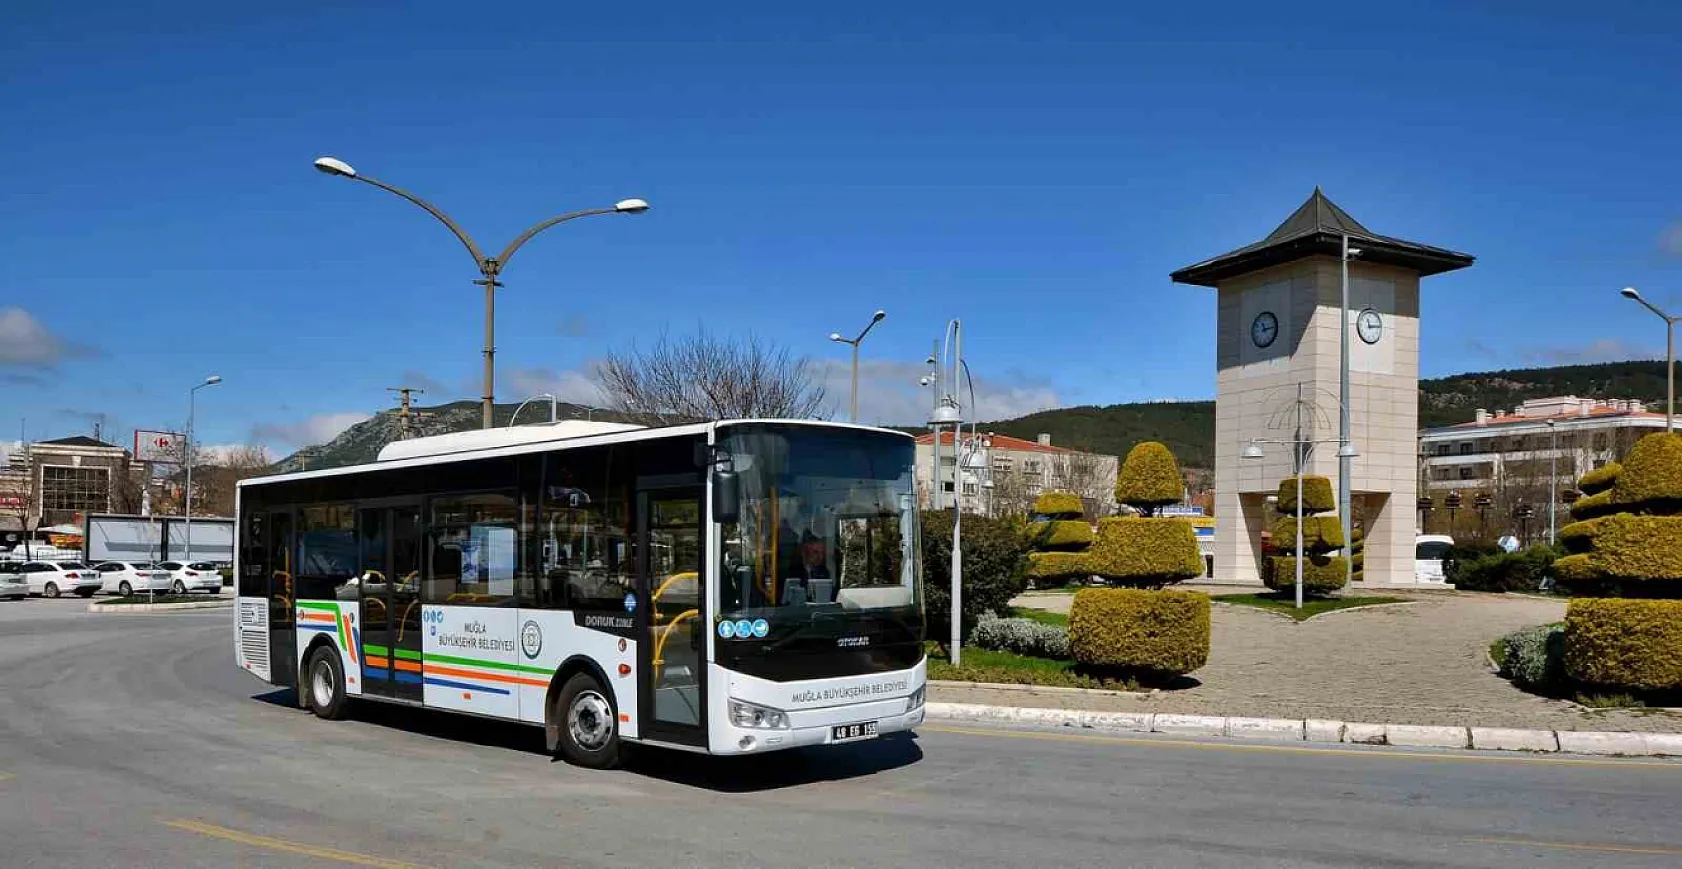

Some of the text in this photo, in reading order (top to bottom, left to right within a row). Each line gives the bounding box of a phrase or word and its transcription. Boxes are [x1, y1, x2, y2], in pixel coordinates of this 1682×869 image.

[464, 621, 486, 633] MUĞLA
[585, 615, 614, 627] DORUK
[837, 636, 869, 646] OTOKAR
[792, 690, 822, 702] MUĞLA
[836, 727, 847, 737] 48
